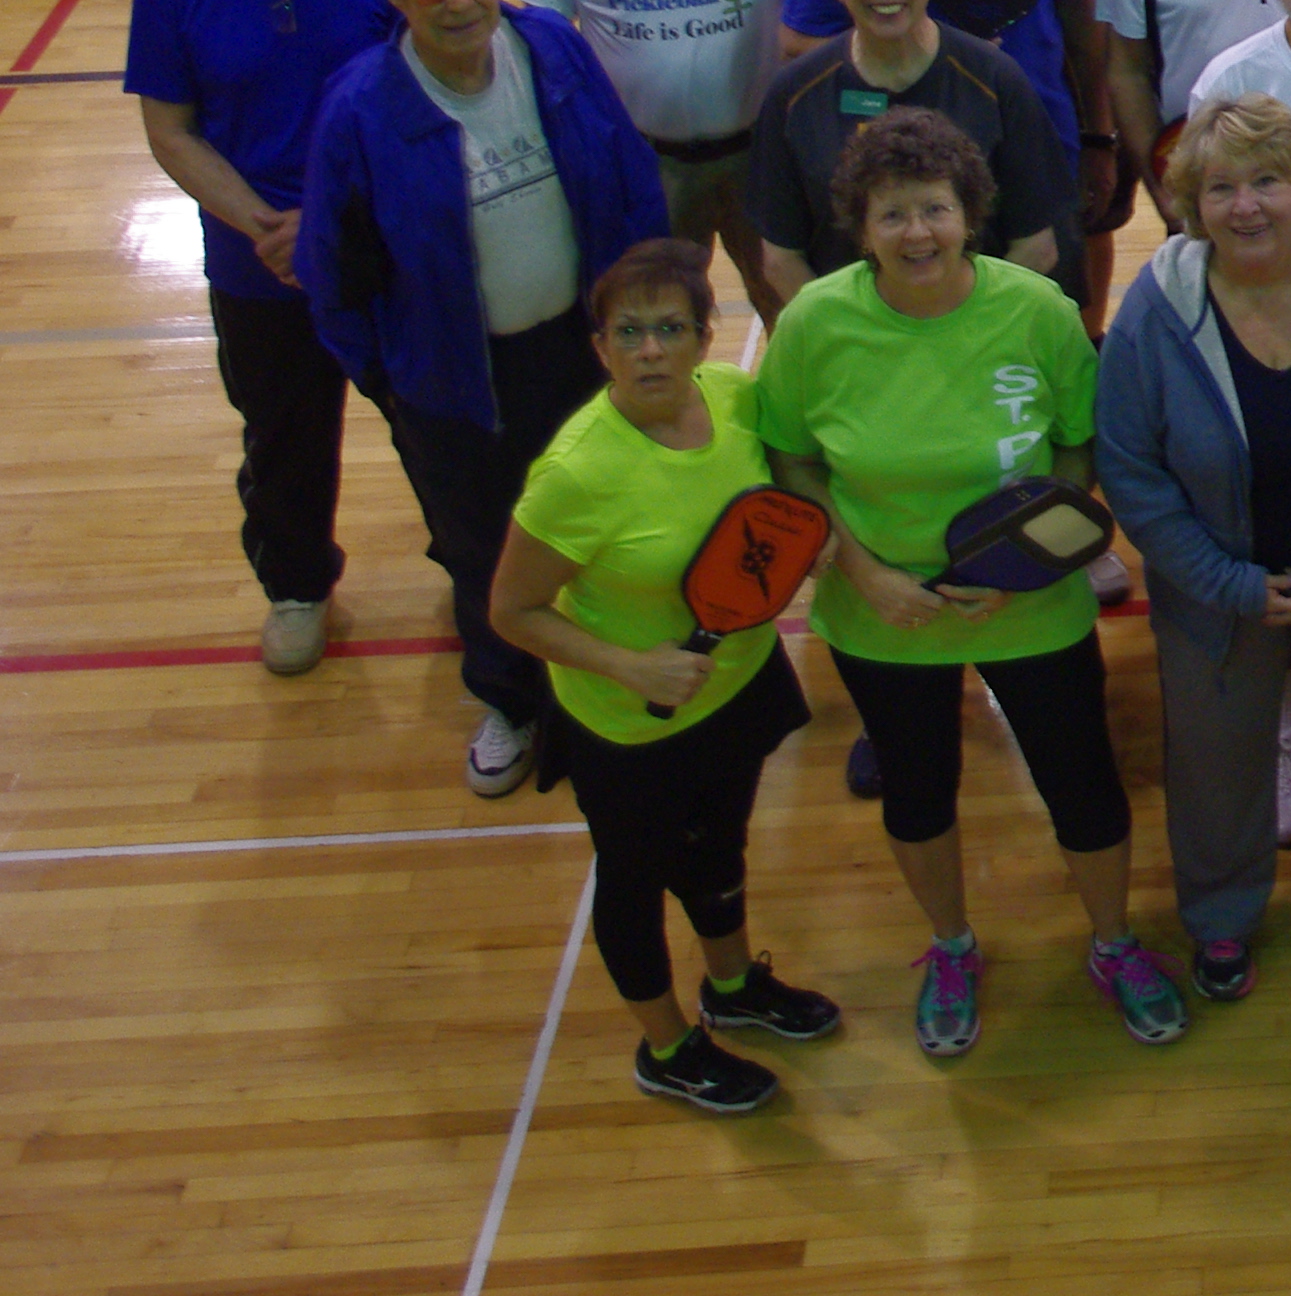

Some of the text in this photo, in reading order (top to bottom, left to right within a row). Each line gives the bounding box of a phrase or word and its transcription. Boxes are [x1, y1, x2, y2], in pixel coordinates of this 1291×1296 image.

[612, 9, 745, 41] Life is Good
